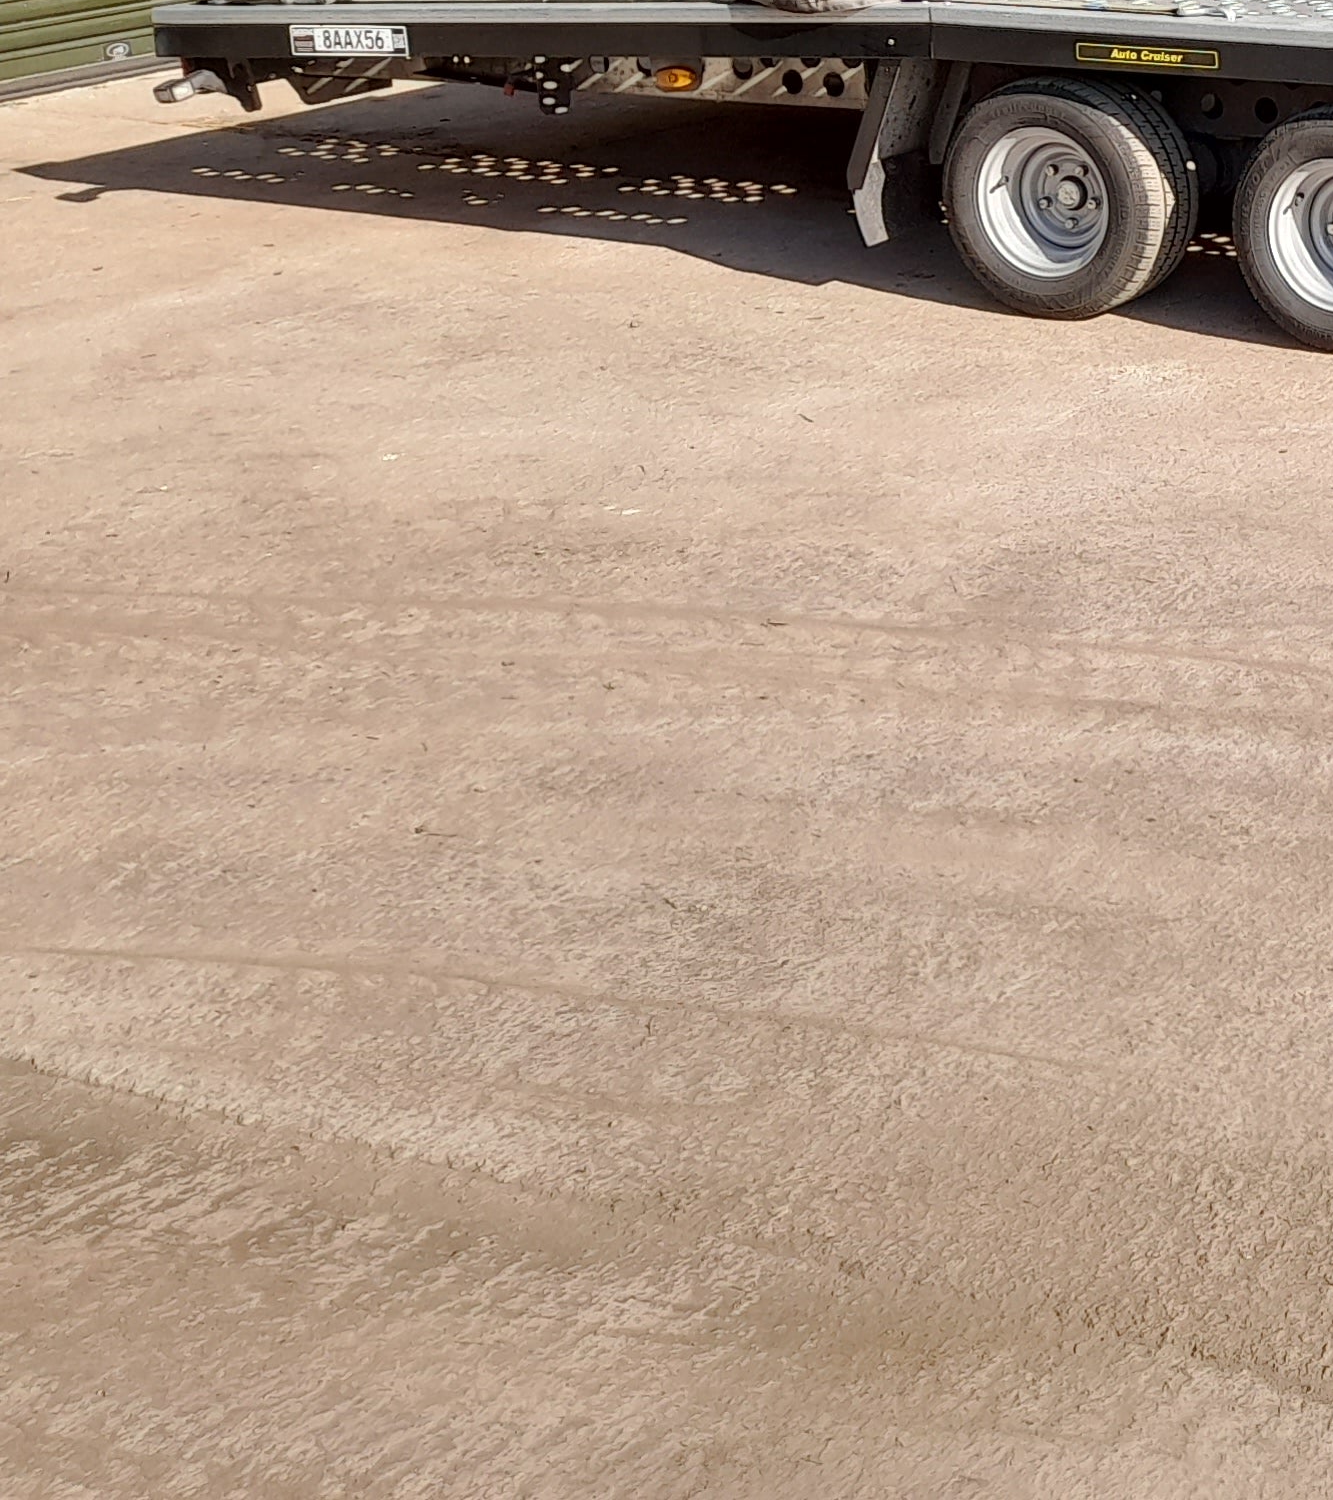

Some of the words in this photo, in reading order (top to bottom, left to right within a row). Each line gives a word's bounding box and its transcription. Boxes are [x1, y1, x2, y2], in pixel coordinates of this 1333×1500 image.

[322, 29, 384, 50] 8AAX56
[1110, 48, 1137, 60] Auto
[1140, 51, 1183, 63] Cruiser
